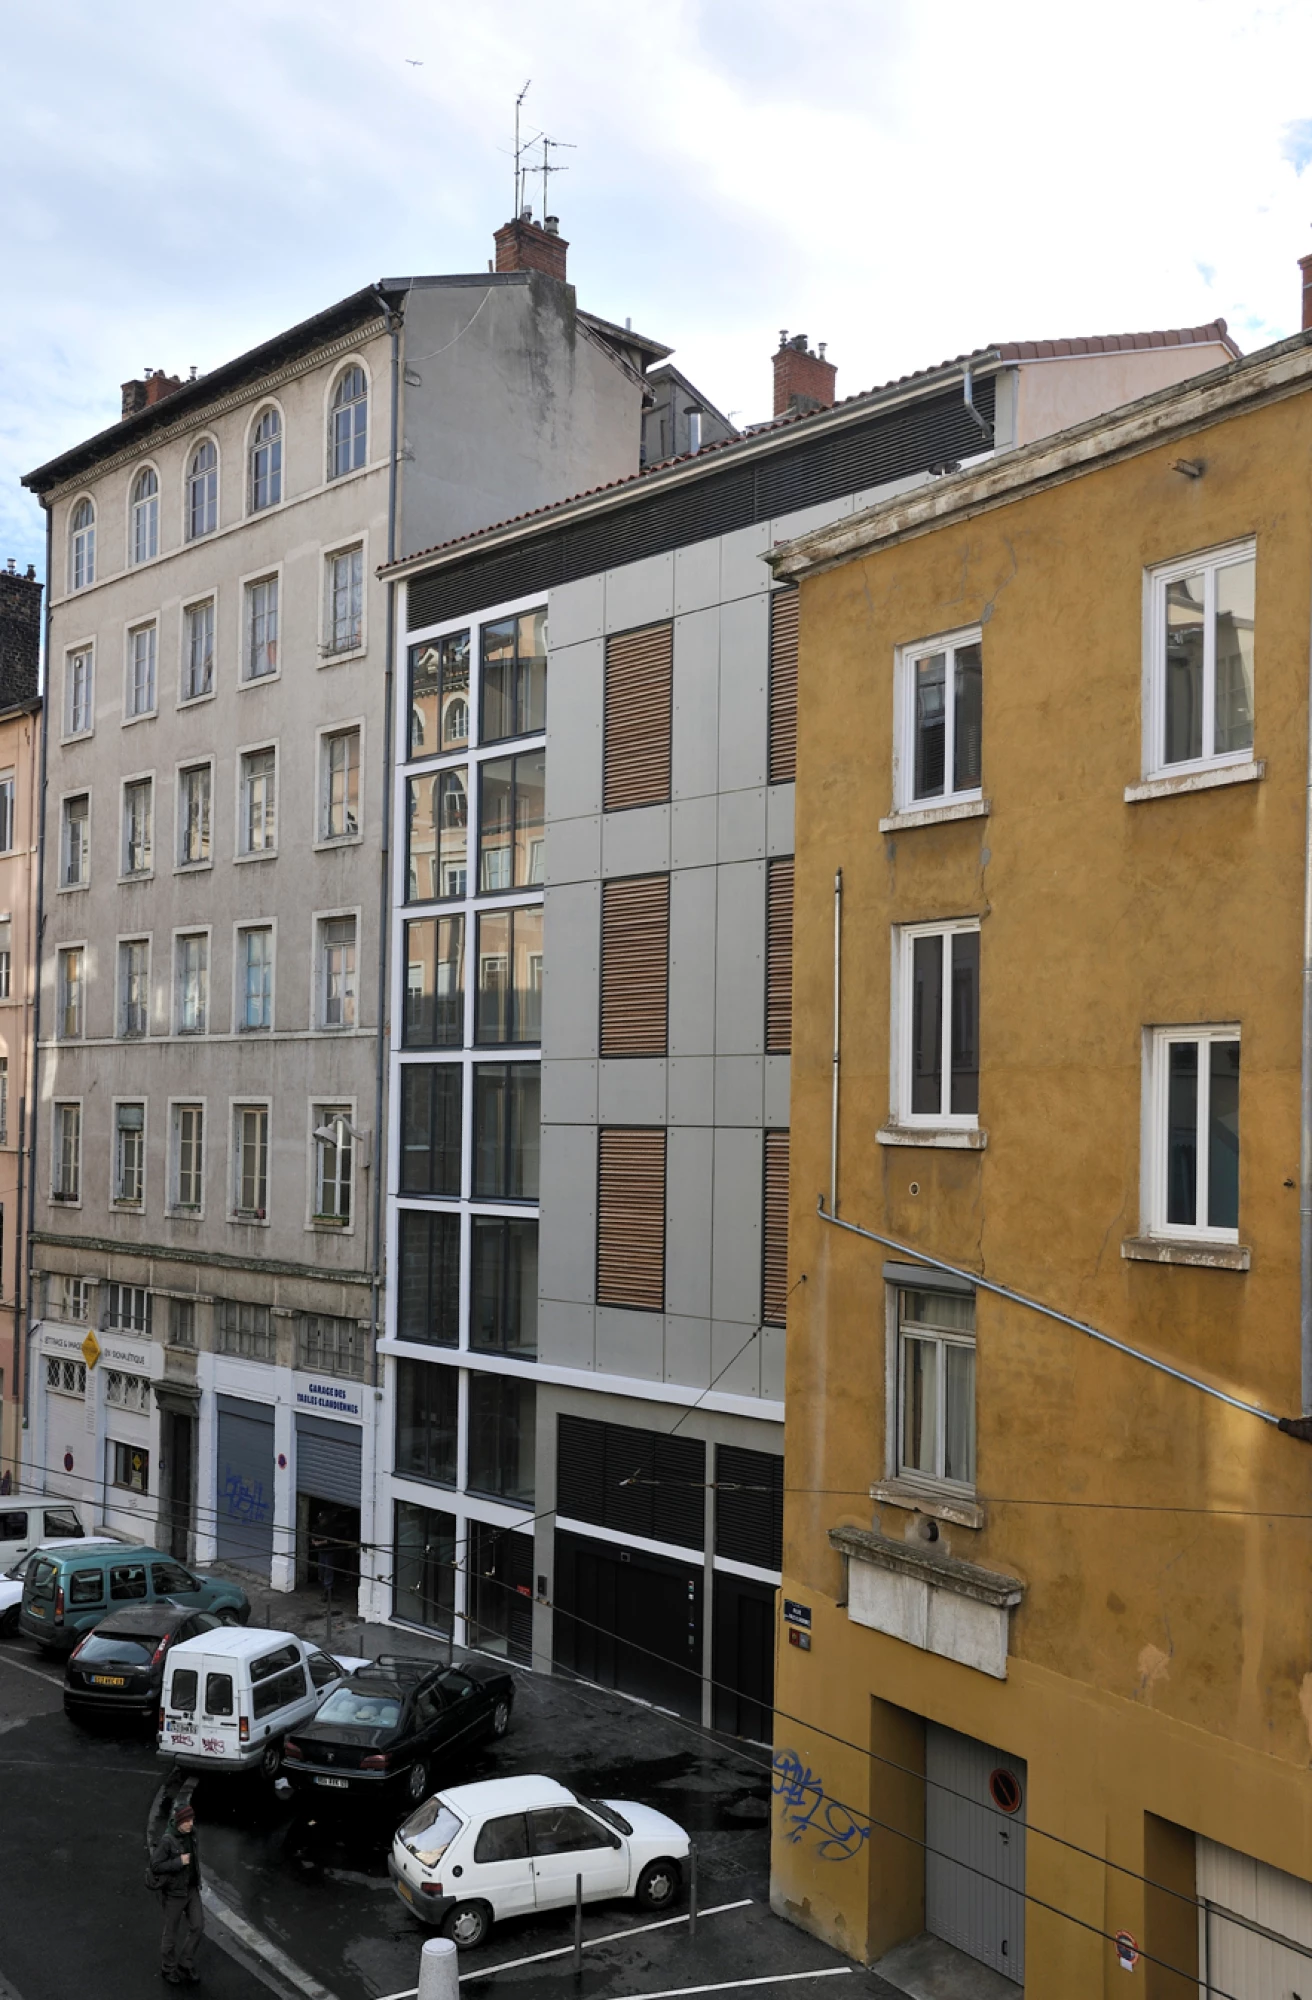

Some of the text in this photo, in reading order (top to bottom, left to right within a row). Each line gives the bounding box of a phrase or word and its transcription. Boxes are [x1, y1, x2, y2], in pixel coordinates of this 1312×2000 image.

[309, 1383, 346, 1399] GARAGE DES
[297, 1393, 358, 1414] TABLES CLAUDIENNES
